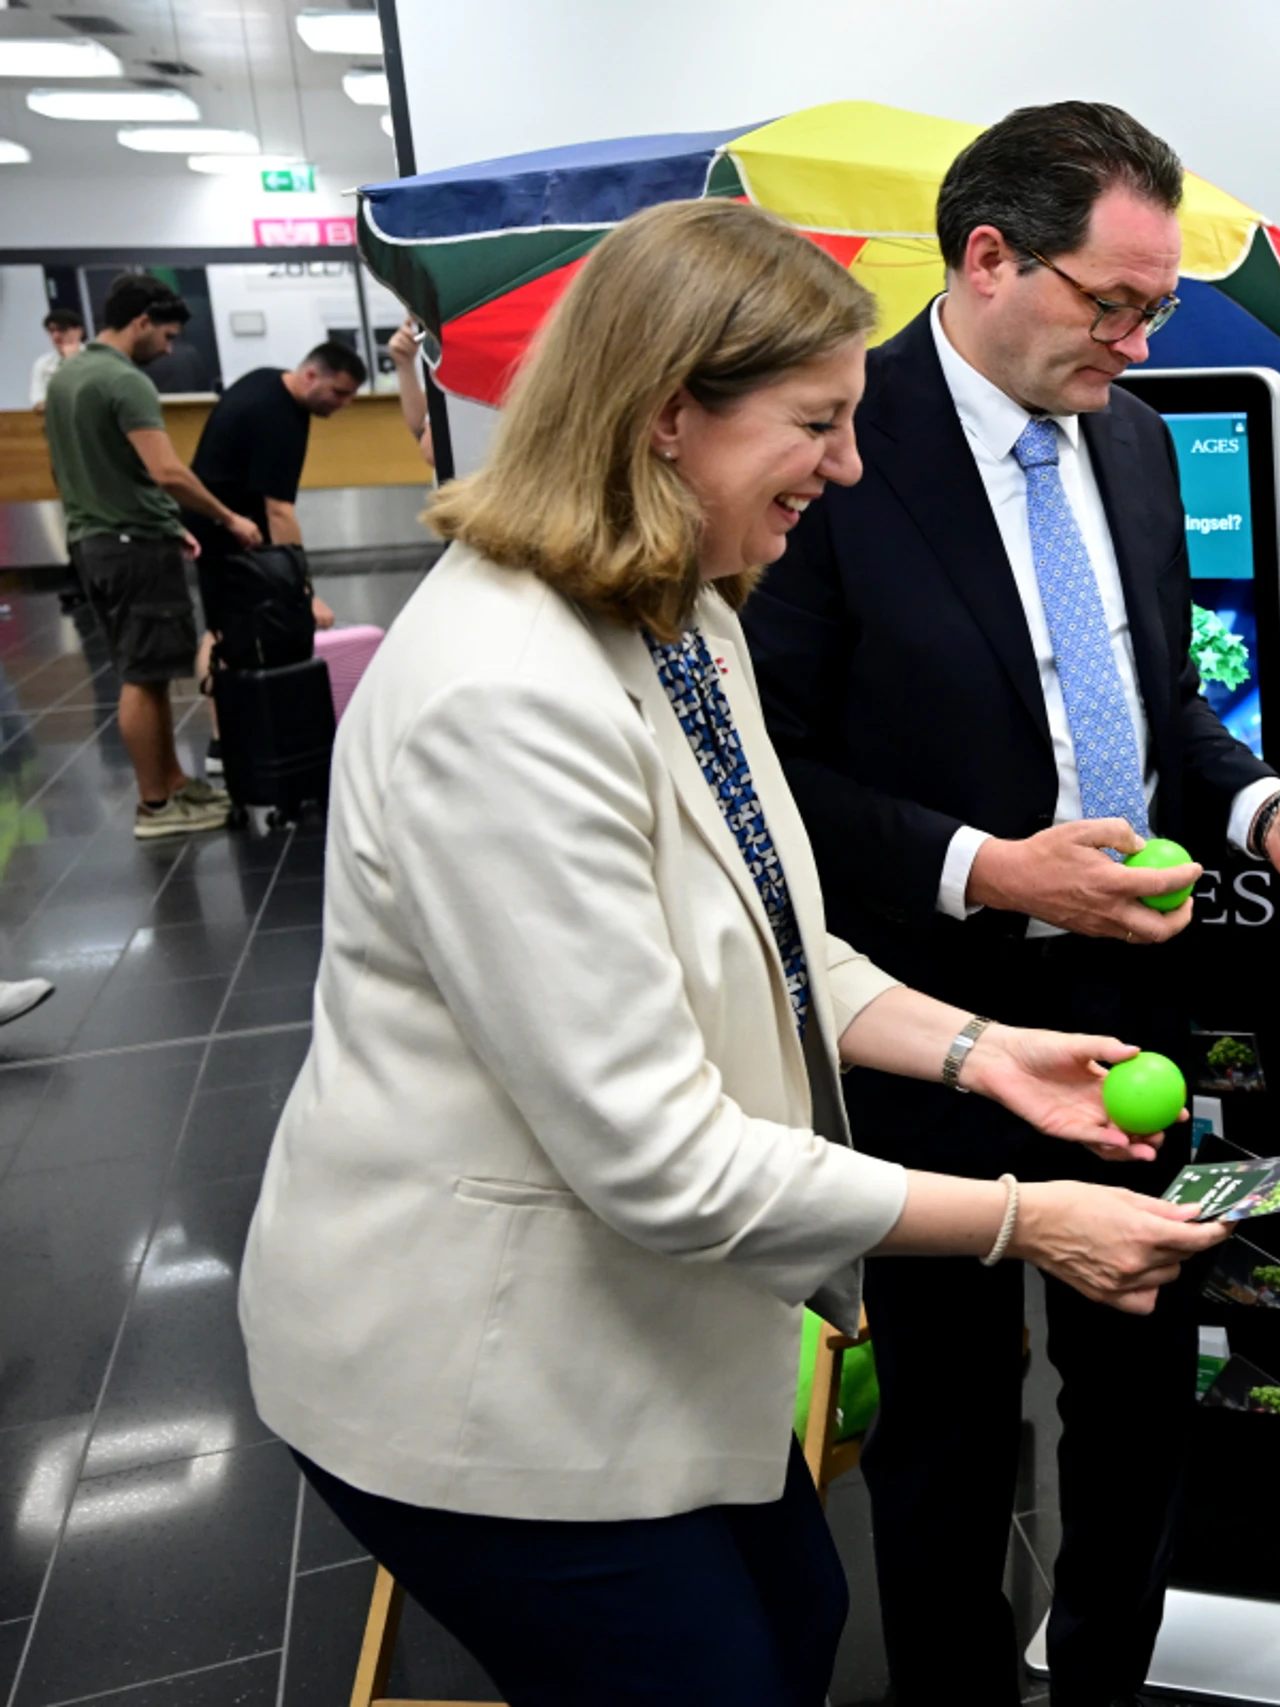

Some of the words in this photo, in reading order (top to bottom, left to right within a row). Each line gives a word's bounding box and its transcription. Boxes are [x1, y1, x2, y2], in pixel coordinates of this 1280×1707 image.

[1190, 438, 1240, 454] AGES
[1184, 513, 1243, 535] ingsel?
[1195, 869, 1275, 927] ES
